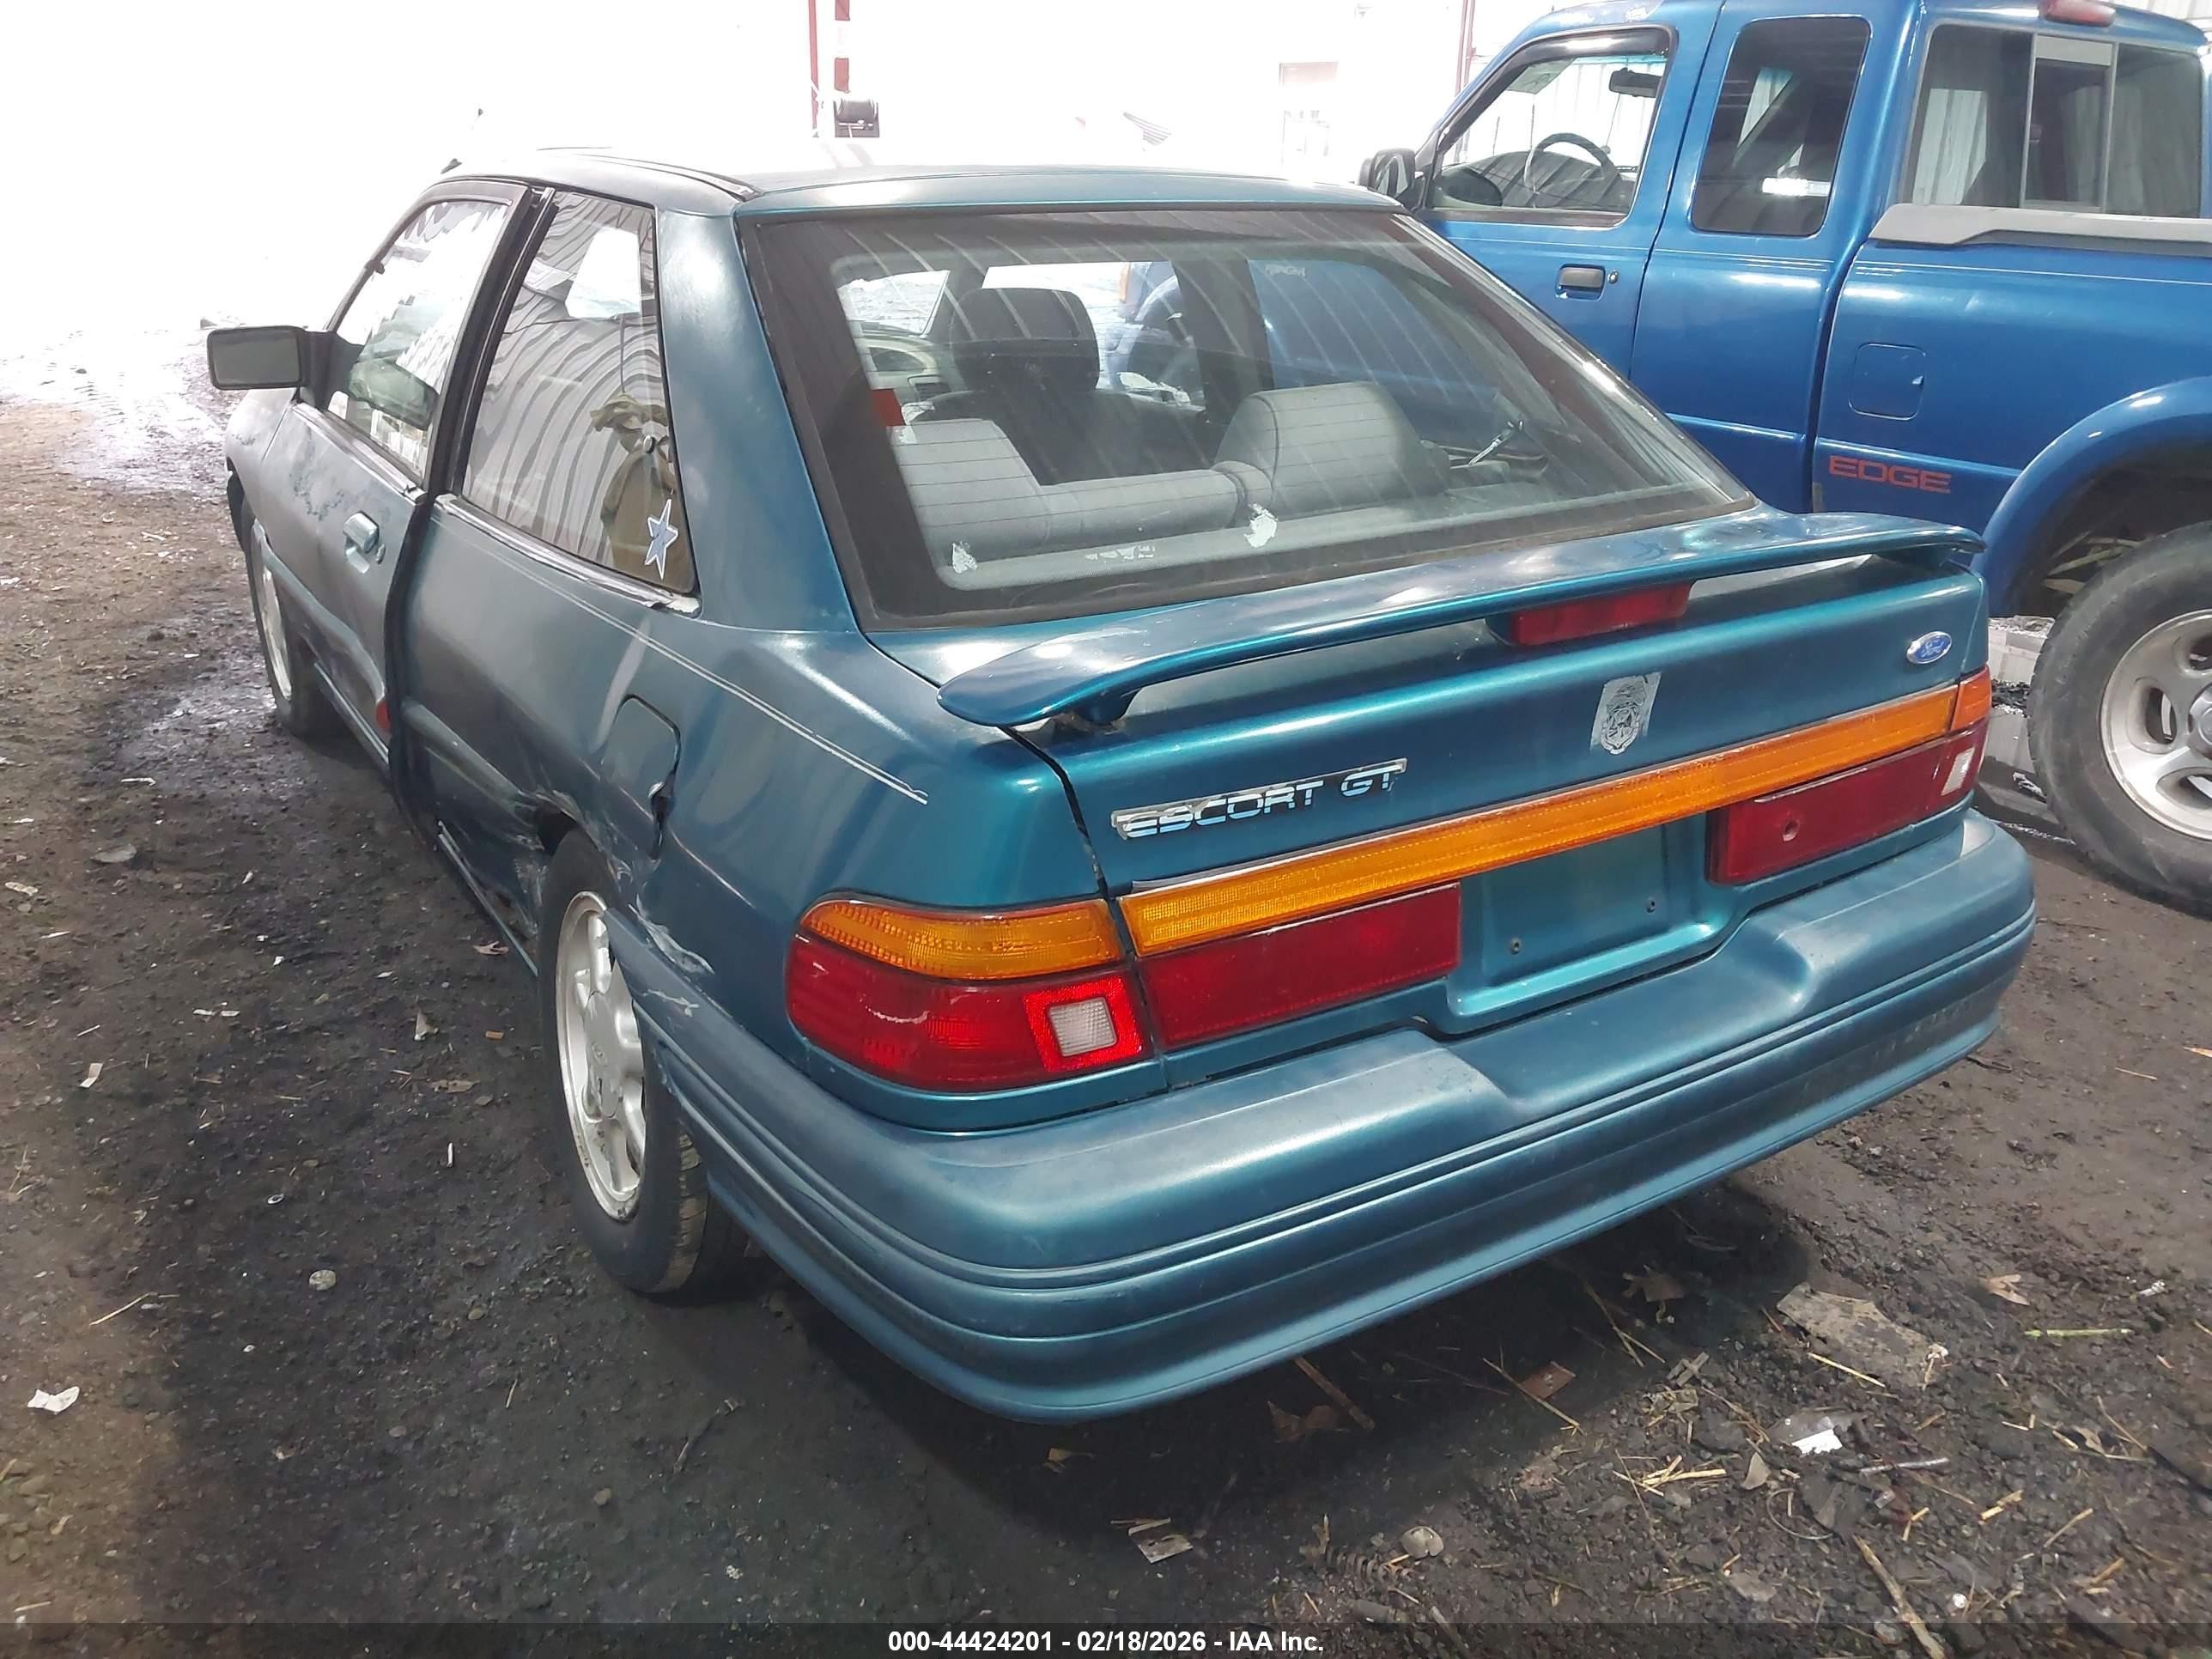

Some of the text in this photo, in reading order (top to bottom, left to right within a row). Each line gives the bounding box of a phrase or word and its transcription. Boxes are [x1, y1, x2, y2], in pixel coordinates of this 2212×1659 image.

[1829, 455, 1952, 495] EDGE
[1115, 763, 1404, 838] ESCORT GT
